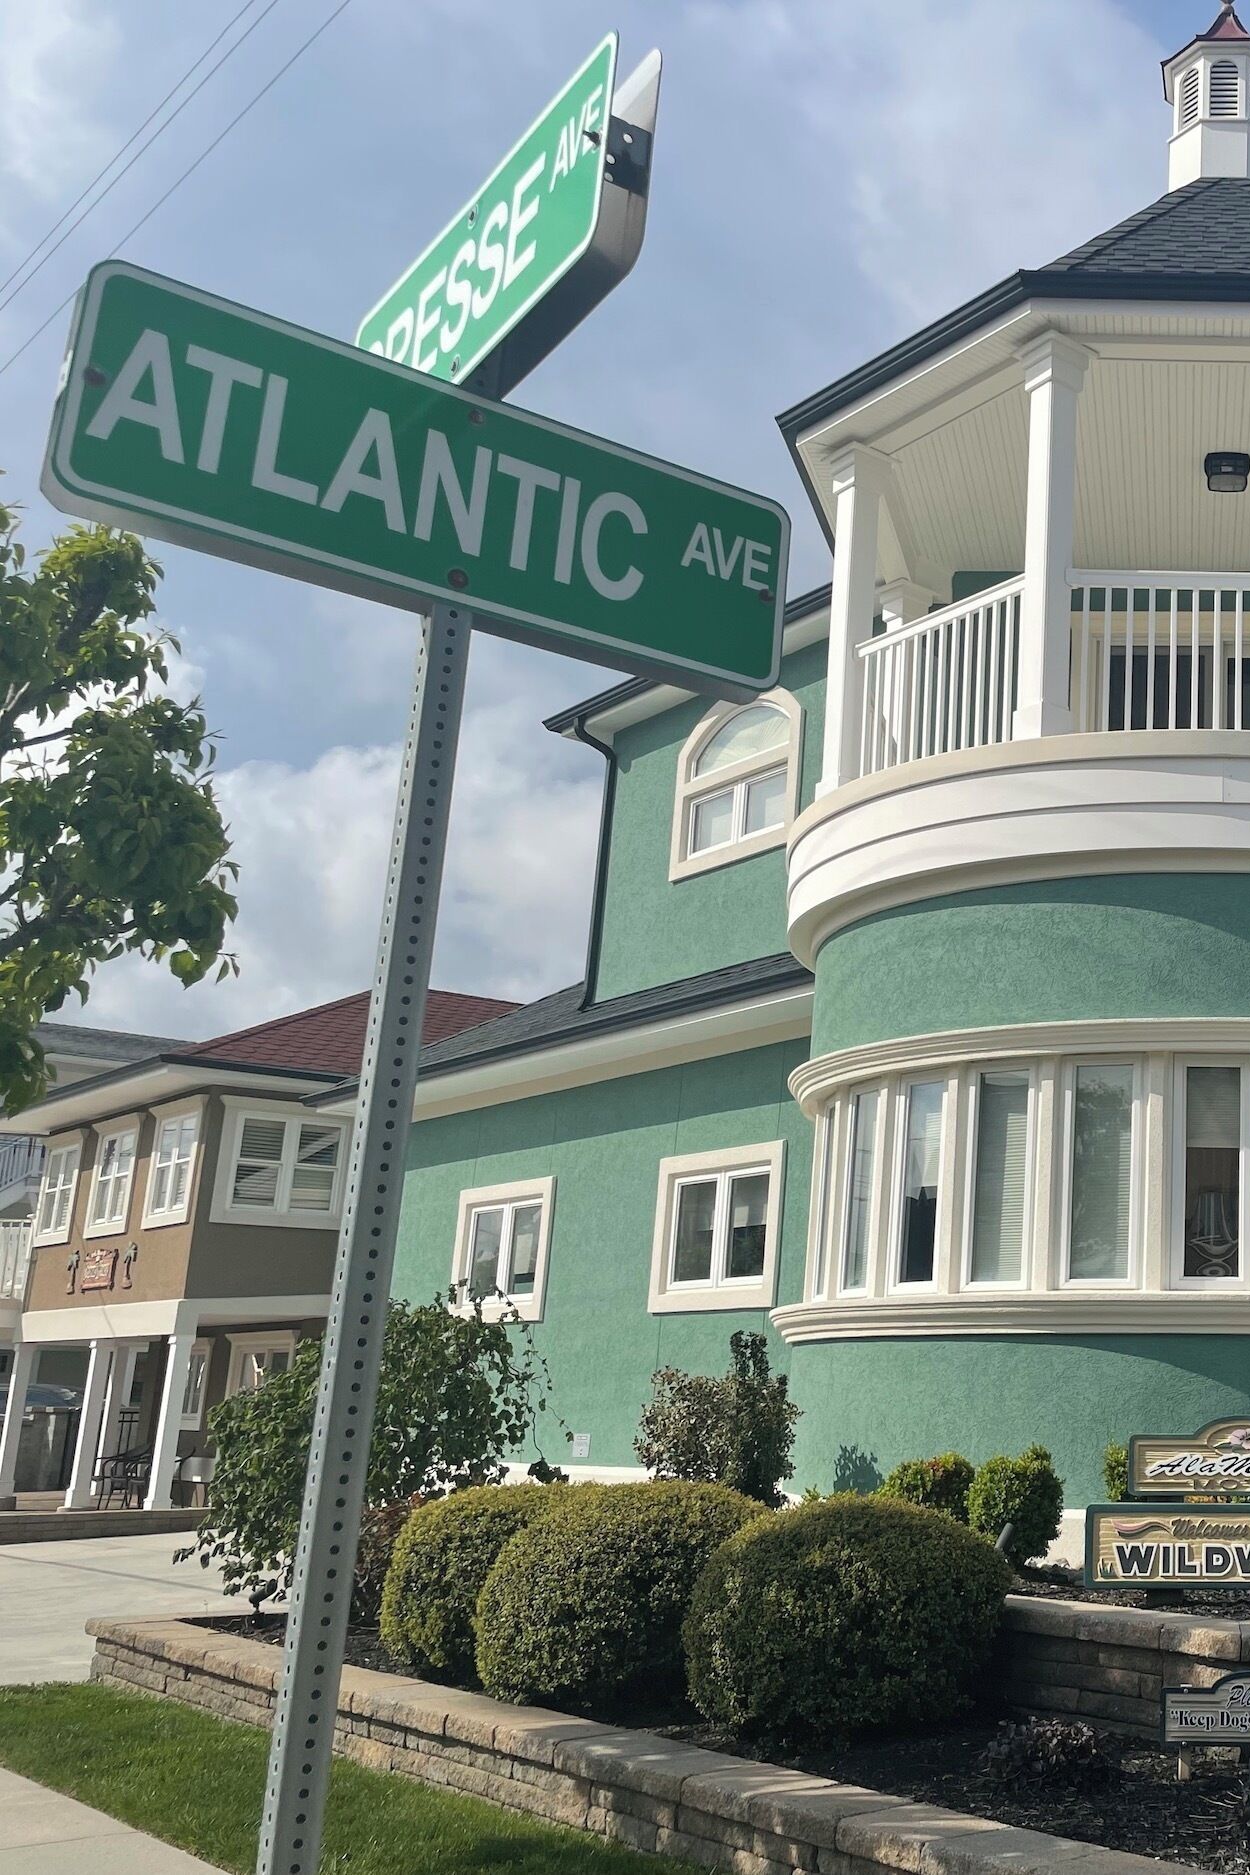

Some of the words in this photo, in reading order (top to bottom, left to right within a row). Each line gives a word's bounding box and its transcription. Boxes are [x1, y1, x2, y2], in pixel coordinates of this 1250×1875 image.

[368, 151, 547, 374] ESSE
[549, 83, 603, 193] AVE
[86, 329, 648, 602] ATLANTIC
[682, 522, 773, 590] AVE
[1171, 1518, 1250, 1541] Welcomes
